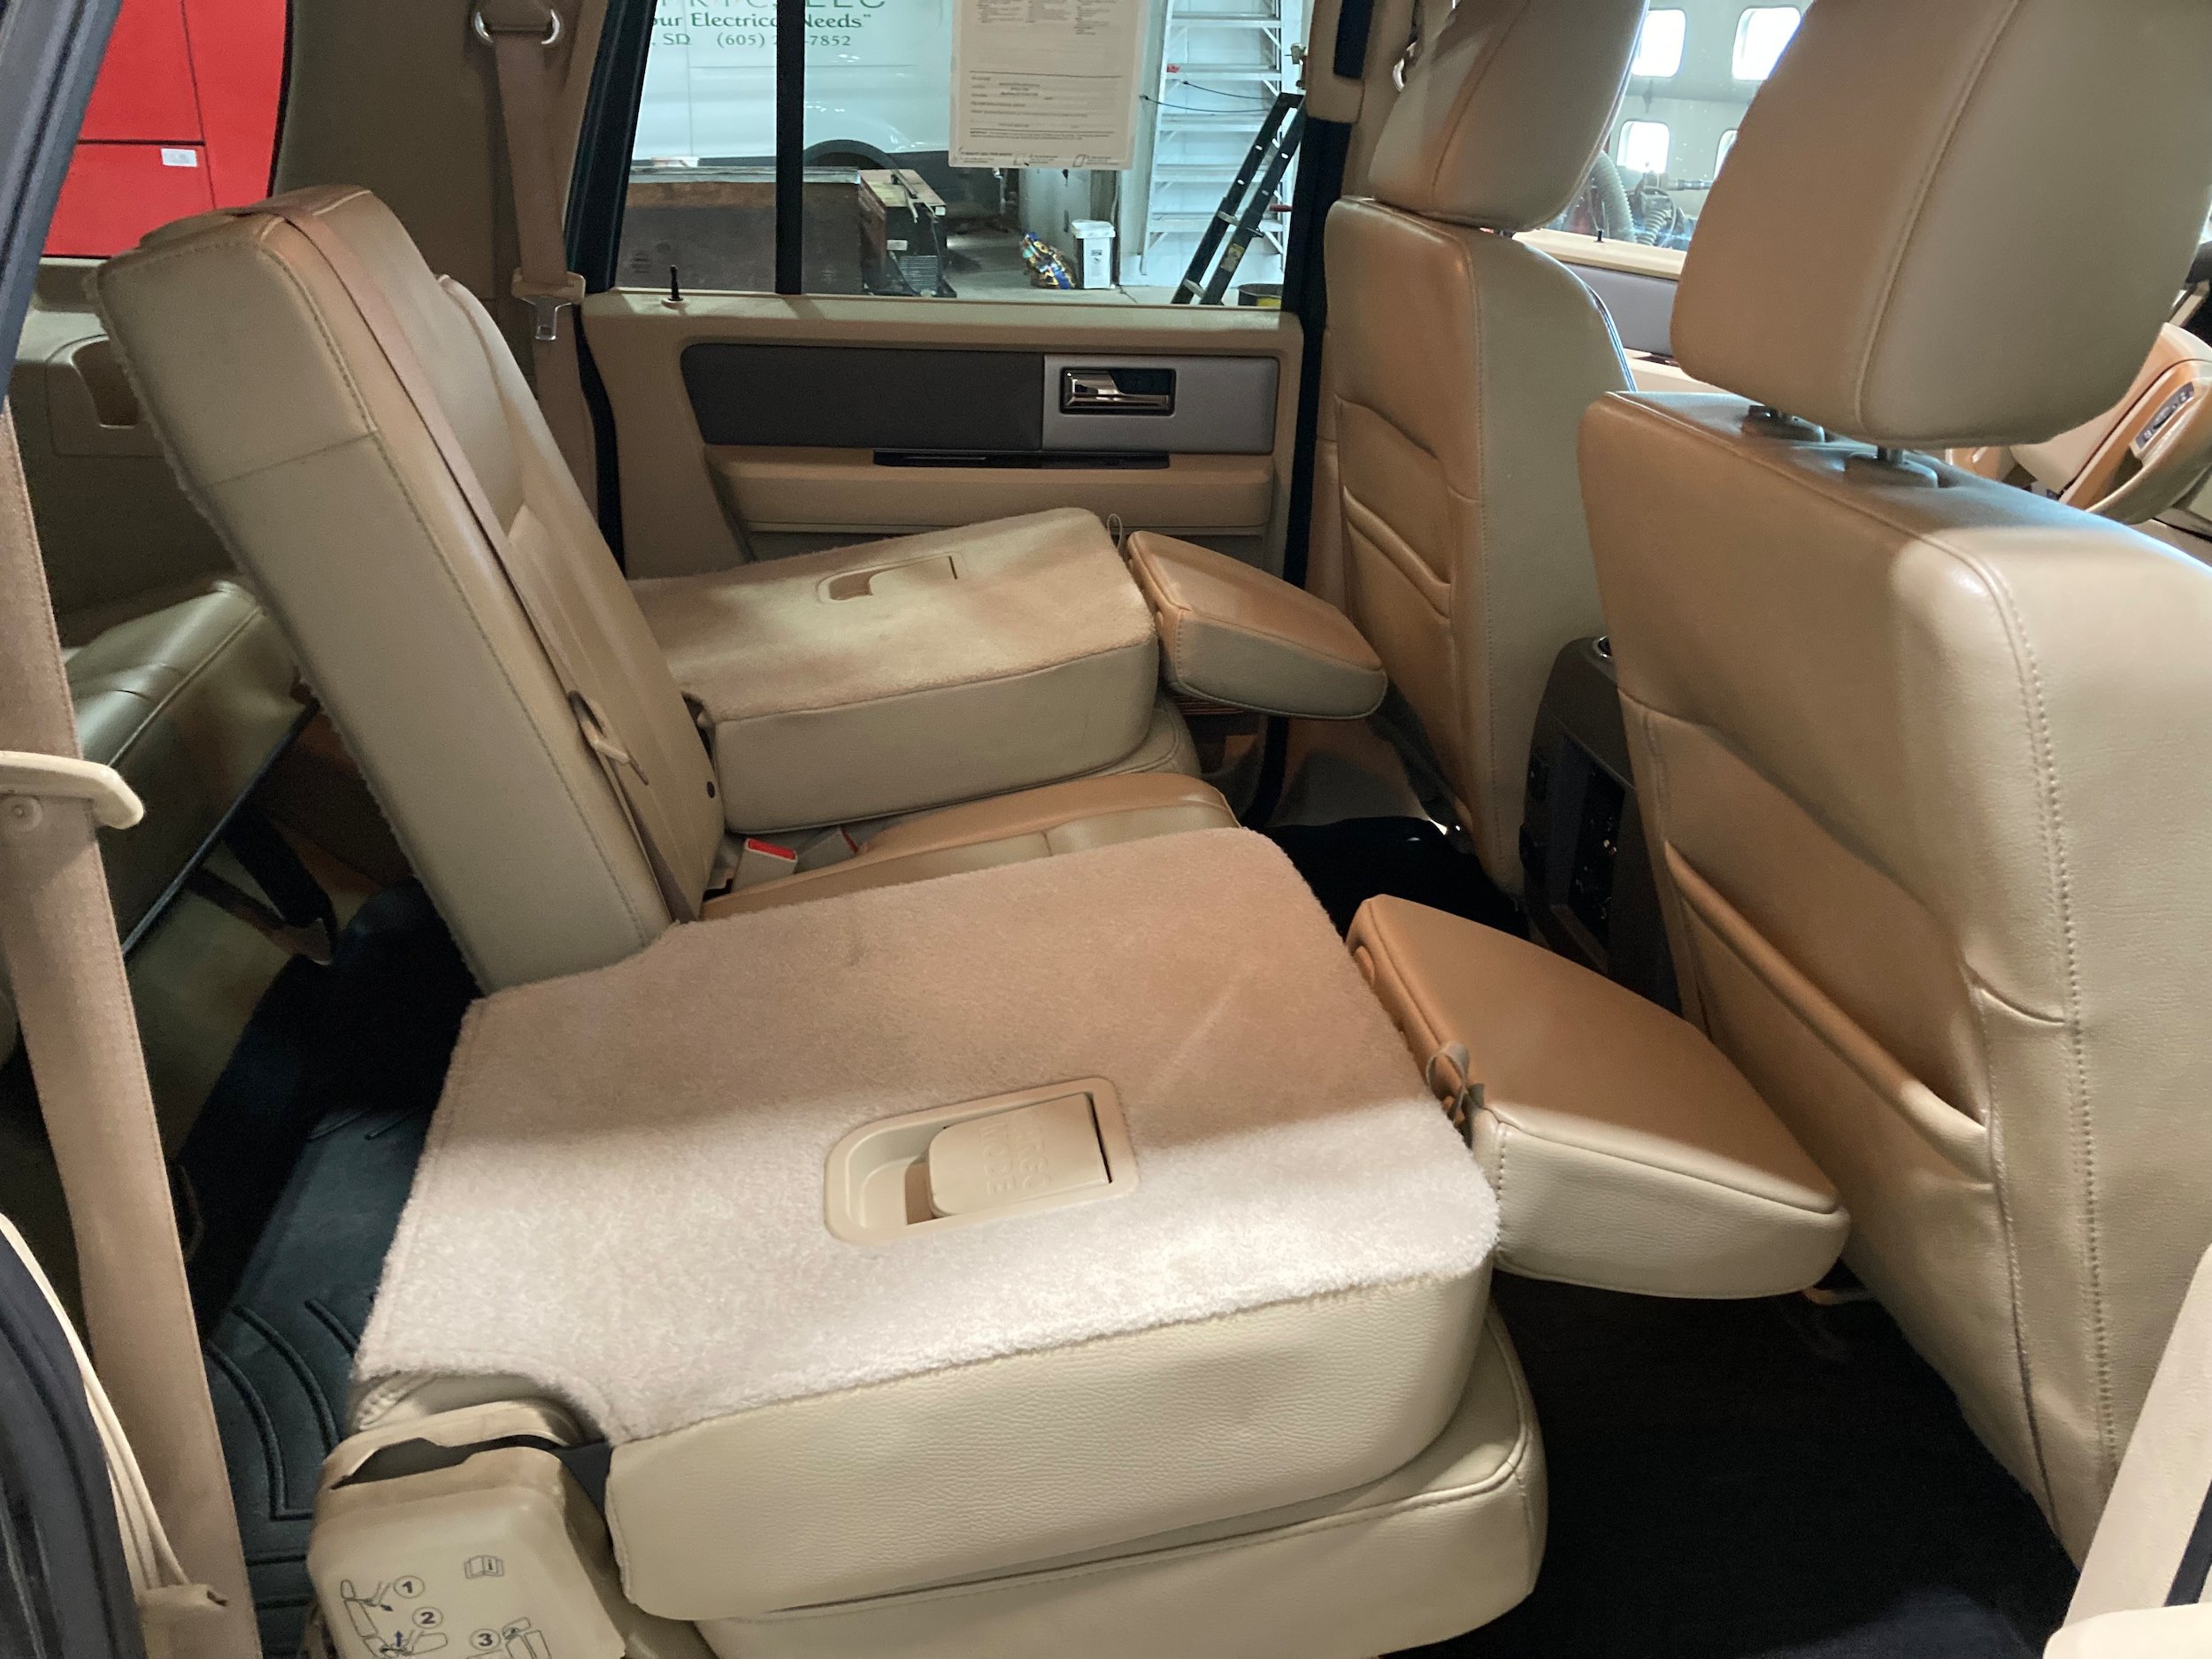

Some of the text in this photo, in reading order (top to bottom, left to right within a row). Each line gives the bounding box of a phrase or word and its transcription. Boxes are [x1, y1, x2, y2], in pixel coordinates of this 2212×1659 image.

[662, 33, 693, 46] SD
[717, 32, 766, 49] (605)
[402, 1580, 413, 1594] 1
[420, 1611, 436, 1624] 2
[477, 1632, 493, 1647] 3
